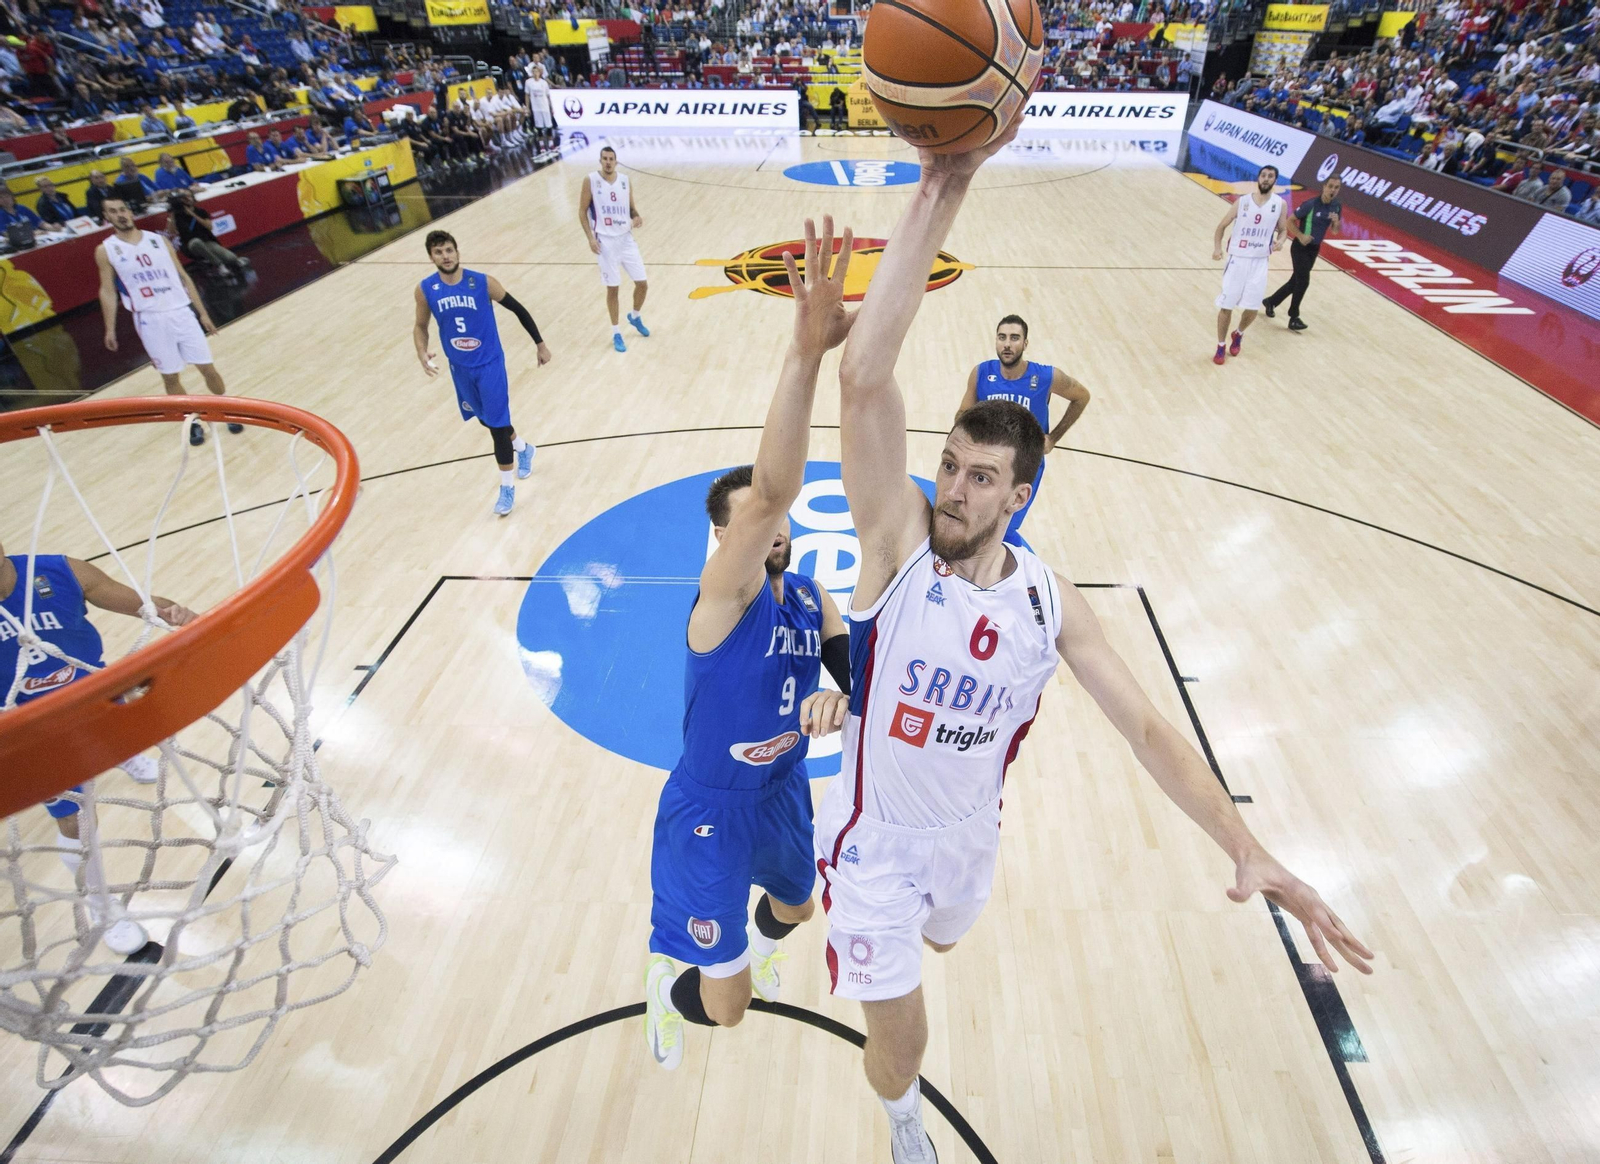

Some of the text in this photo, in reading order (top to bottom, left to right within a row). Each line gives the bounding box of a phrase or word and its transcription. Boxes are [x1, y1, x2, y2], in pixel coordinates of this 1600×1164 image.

[595, 102, 669, 115] JAPAN
[676, 102, 788, 116] AIRLINES
[1062, 105, 1176, 118] AIRLINES
[1213, 120, 1289, 157] JAPAN AIRLINES
[610, 191, 618, 202] 8
[1340, 166, 1487, 236] JAPAN AIRLINES
[1254, 213, 1262, 225] 9
[136, 253, 153, 268] 10
[1323, 239, 1537, 315] BERLIN
[437, 295, 477, 313] ITALIA
[454, 316, 467, 333] 5
[969, 614, 1001, 661] 6
[778, 676, 796, 716] 9
[935, 723, 999, 752] triglav
[693, 923, 711, 940] FIAT
[848, 970, 872, 984] mts
